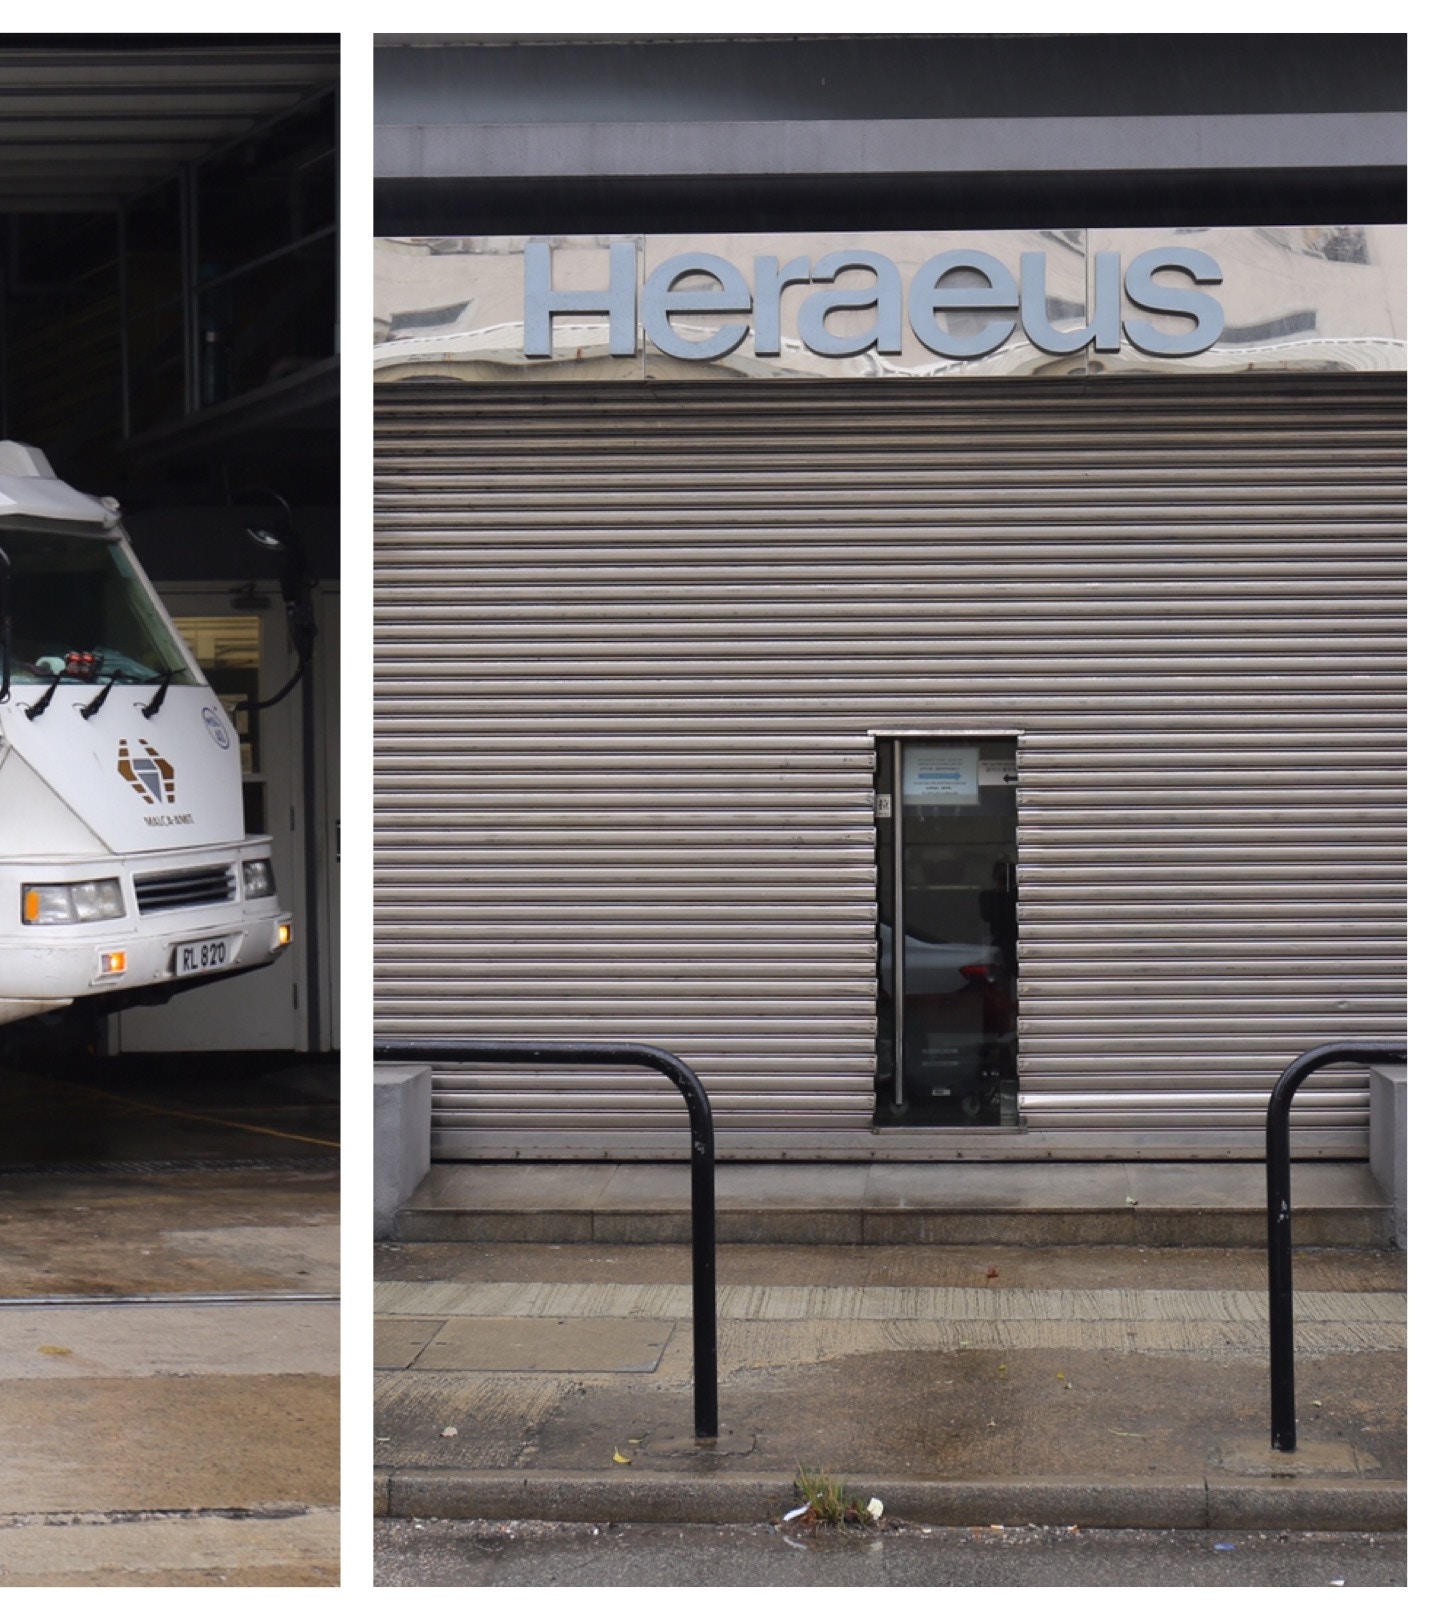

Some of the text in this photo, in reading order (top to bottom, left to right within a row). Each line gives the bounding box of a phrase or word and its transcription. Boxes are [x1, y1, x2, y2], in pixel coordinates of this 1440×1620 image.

[523, 242, 1225, 361] Heraeus
[182, 941, 227, 971] RL 820
